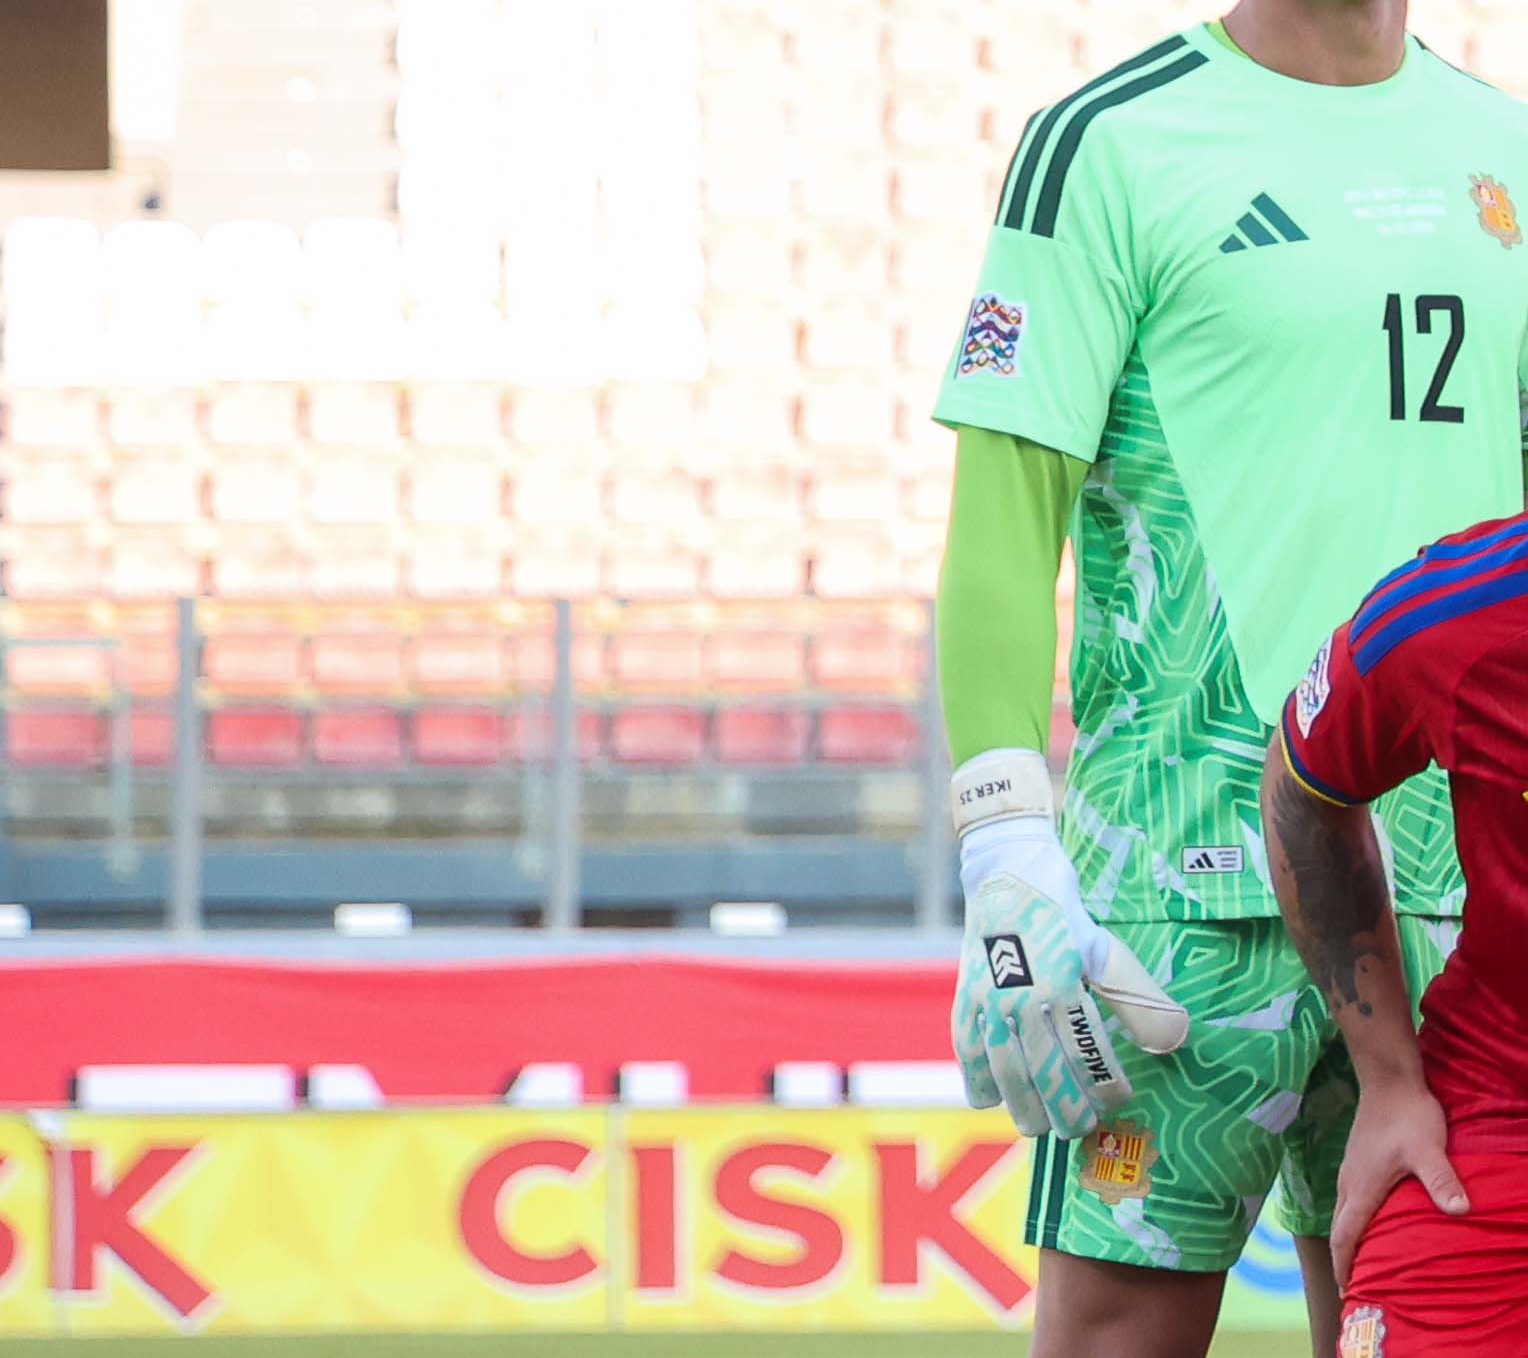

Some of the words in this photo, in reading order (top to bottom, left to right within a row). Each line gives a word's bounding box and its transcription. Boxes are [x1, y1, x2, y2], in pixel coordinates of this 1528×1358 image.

[1382, 293, 1465, 423] 12
[975, 779, 1011, 798] IKER
[1068, 1005, 1112, 1082] TWOFIVE
[457, 1137, 1035, 1313] CISK
